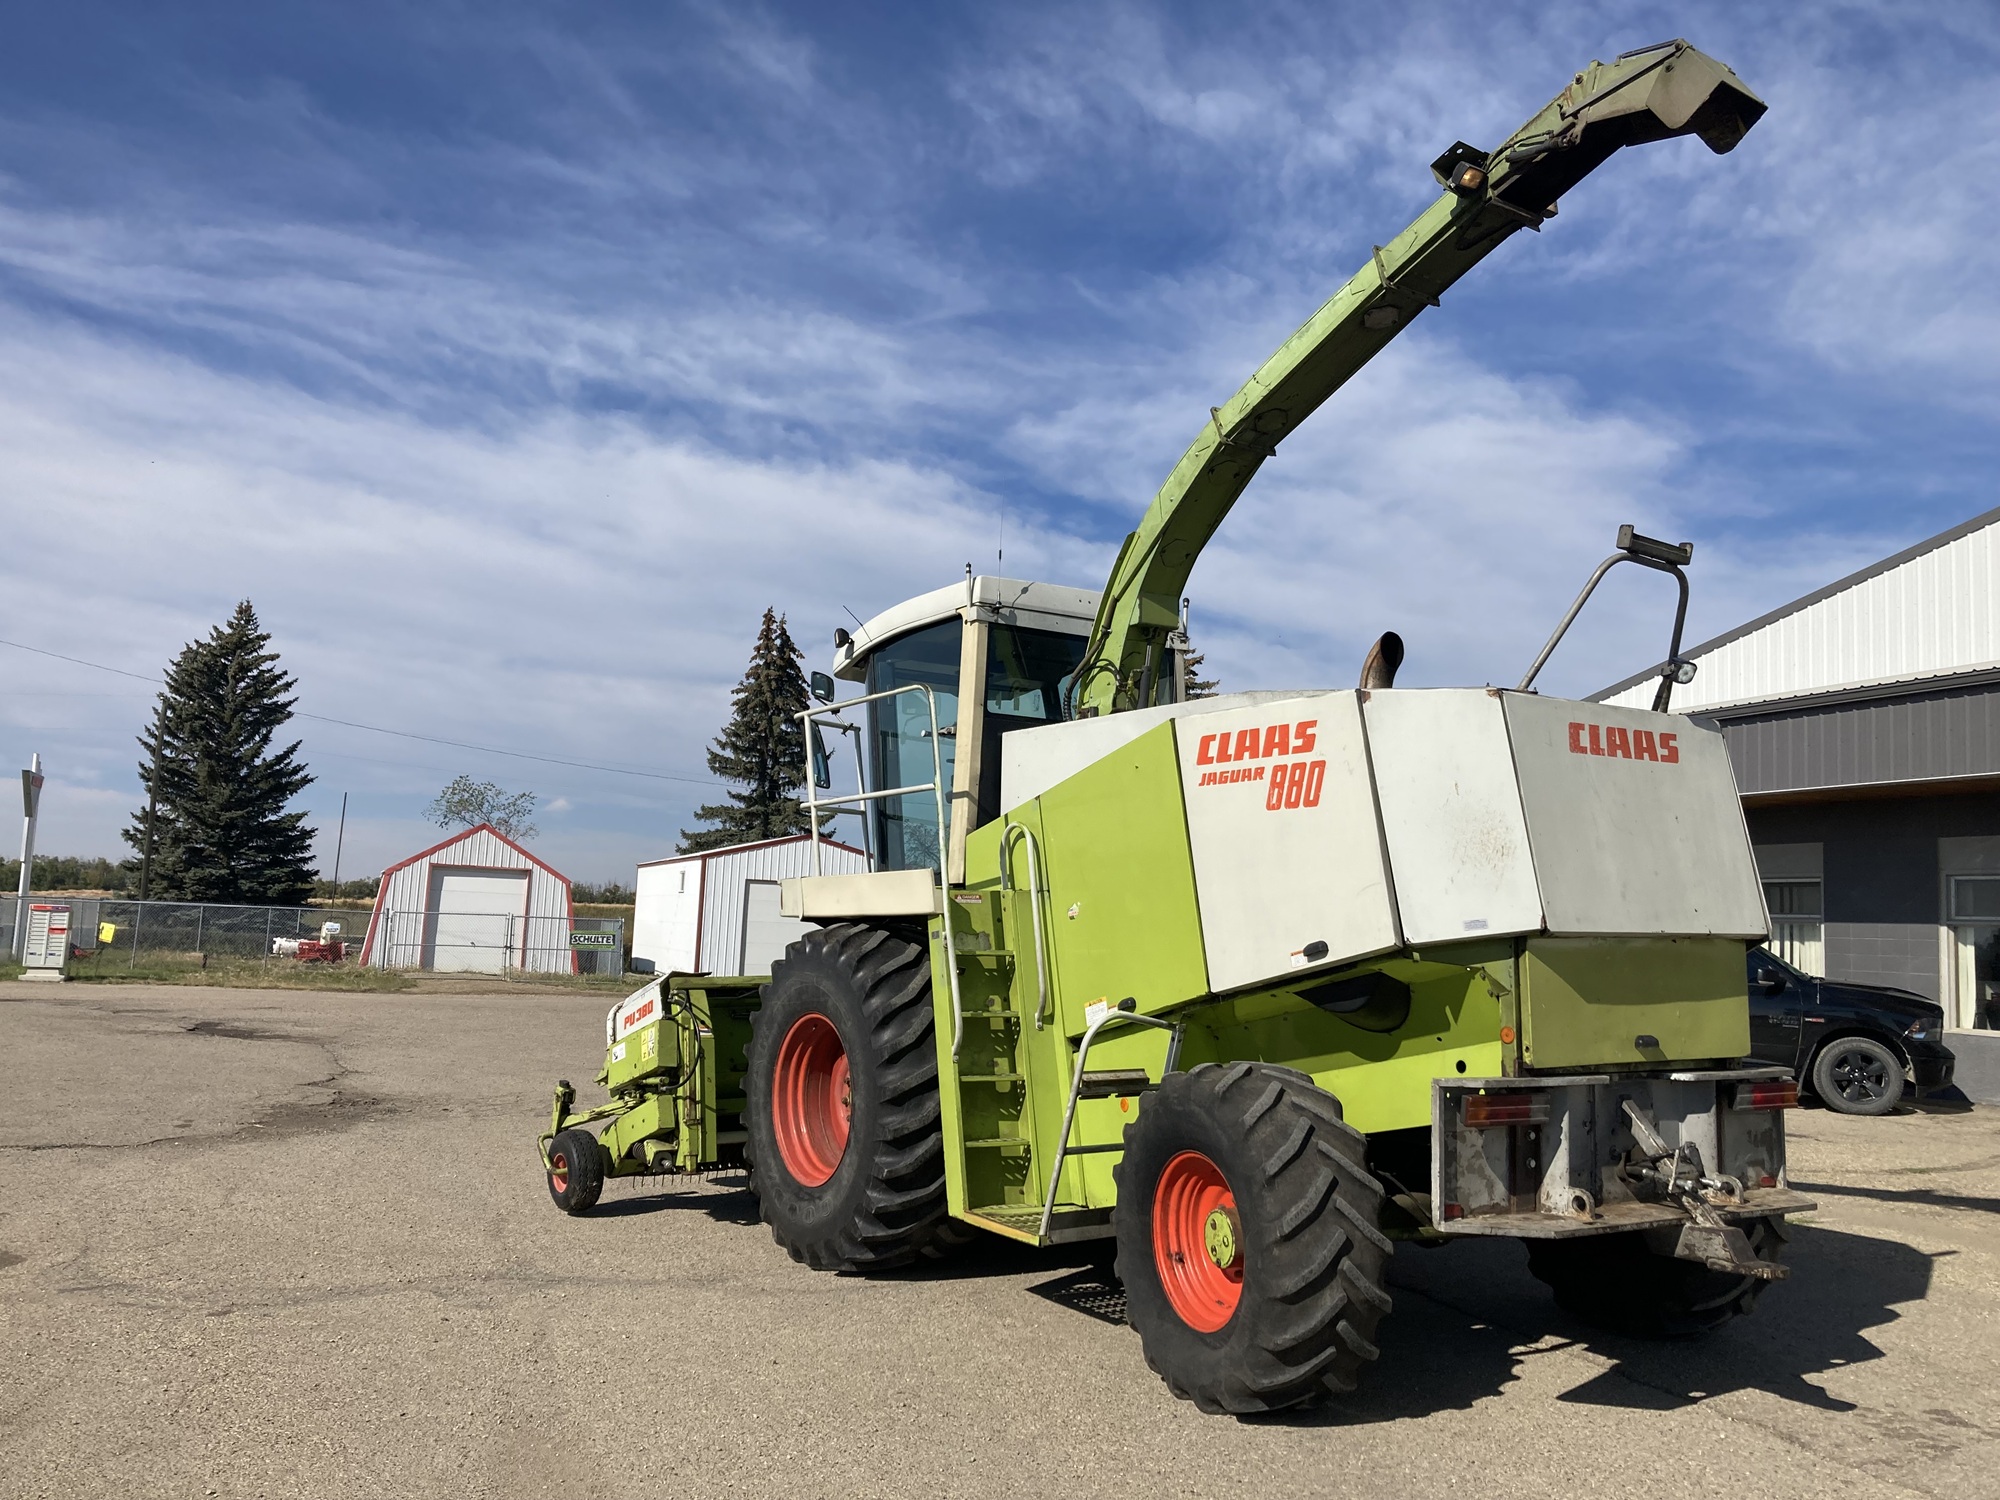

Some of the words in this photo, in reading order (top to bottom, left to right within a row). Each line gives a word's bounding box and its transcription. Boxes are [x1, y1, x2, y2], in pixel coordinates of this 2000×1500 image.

[1195, 719, 1318, 766] CLAAS
[1568, 722, 1680, 764] CLAAS
[1198, 765, 1265, 787] JAGUAR
[1265, 759, 1327, 811] 880
[572, 935, 612, 944] SCHULTE
[624, 1012, 635, 1030] PU
[636, 1000, 653, 1022] 380
